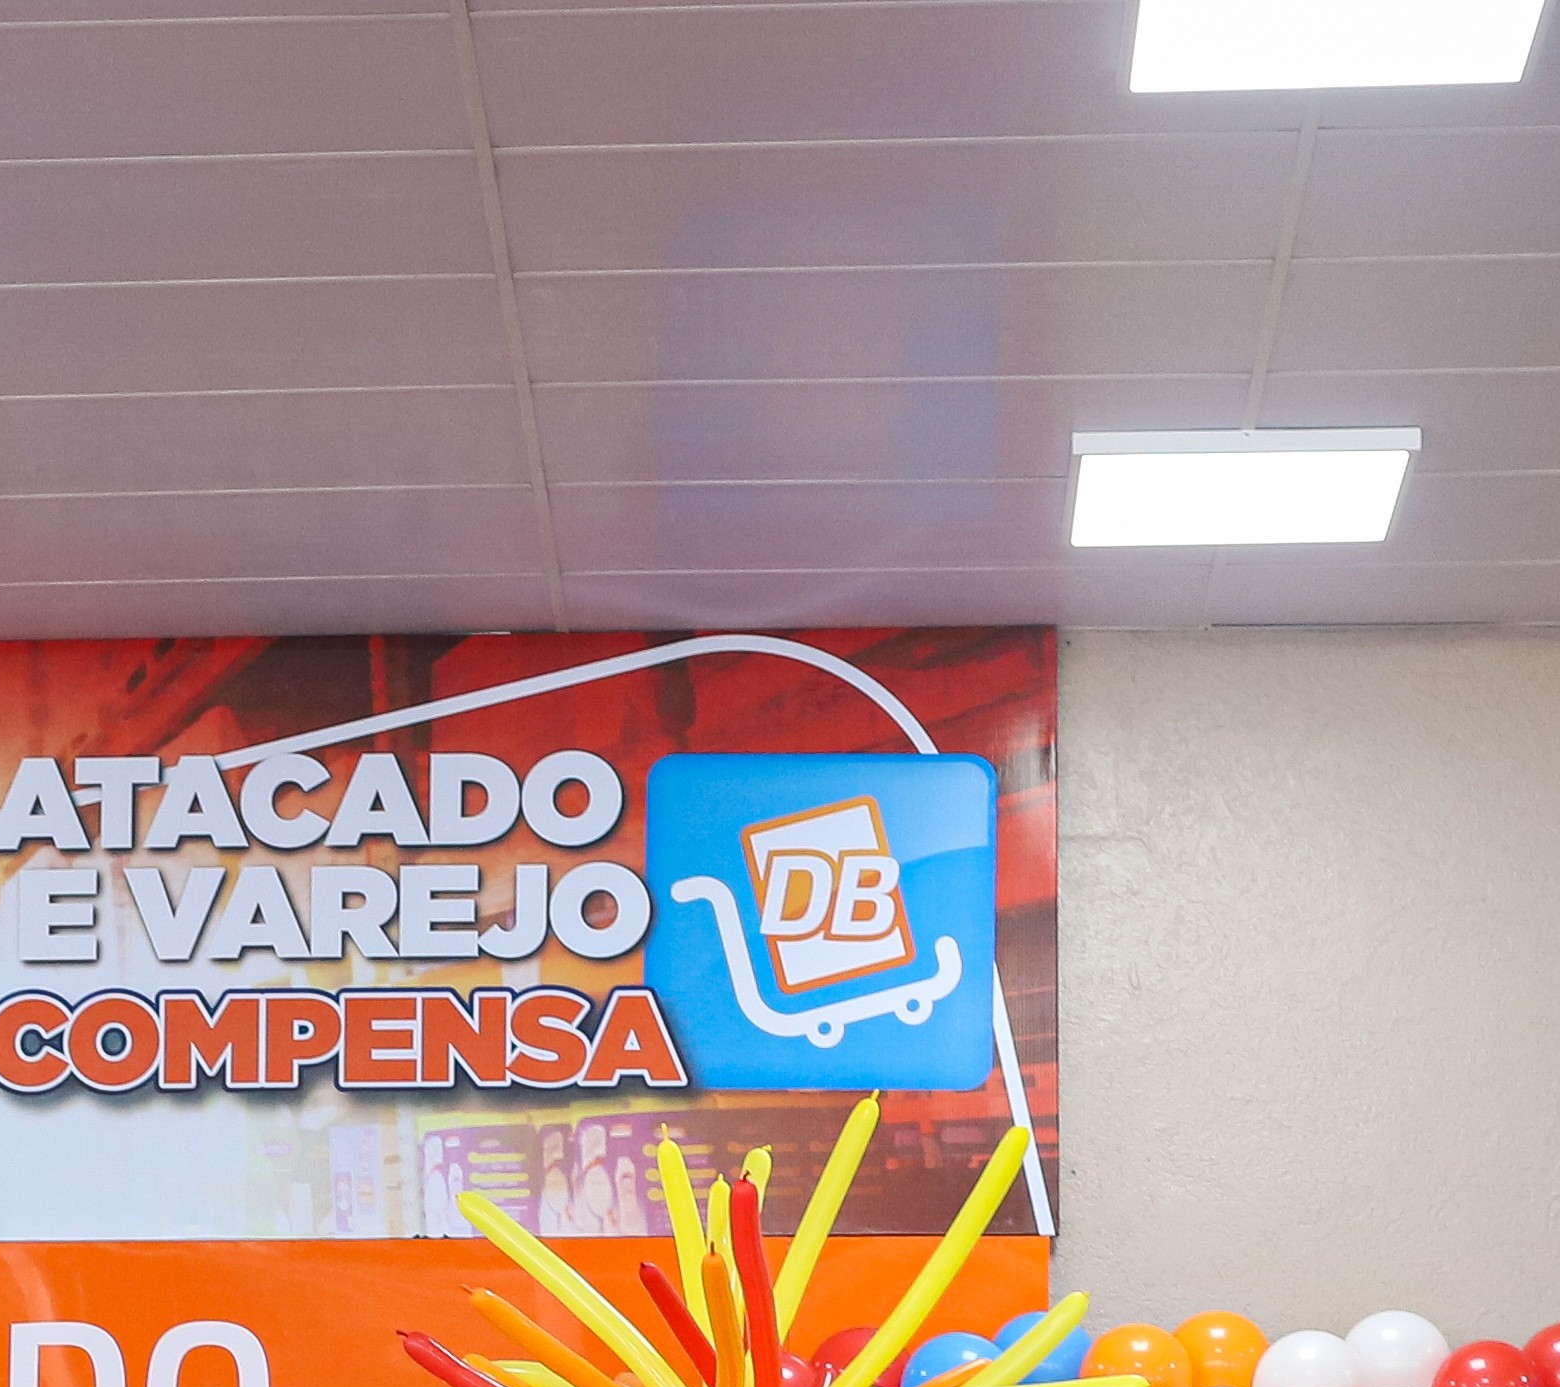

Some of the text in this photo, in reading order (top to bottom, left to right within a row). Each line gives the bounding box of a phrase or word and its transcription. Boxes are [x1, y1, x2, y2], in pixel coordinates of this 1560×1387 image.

[19, 860, 652, 963] E VAREJO
[759, 850, 901, 946] DB
